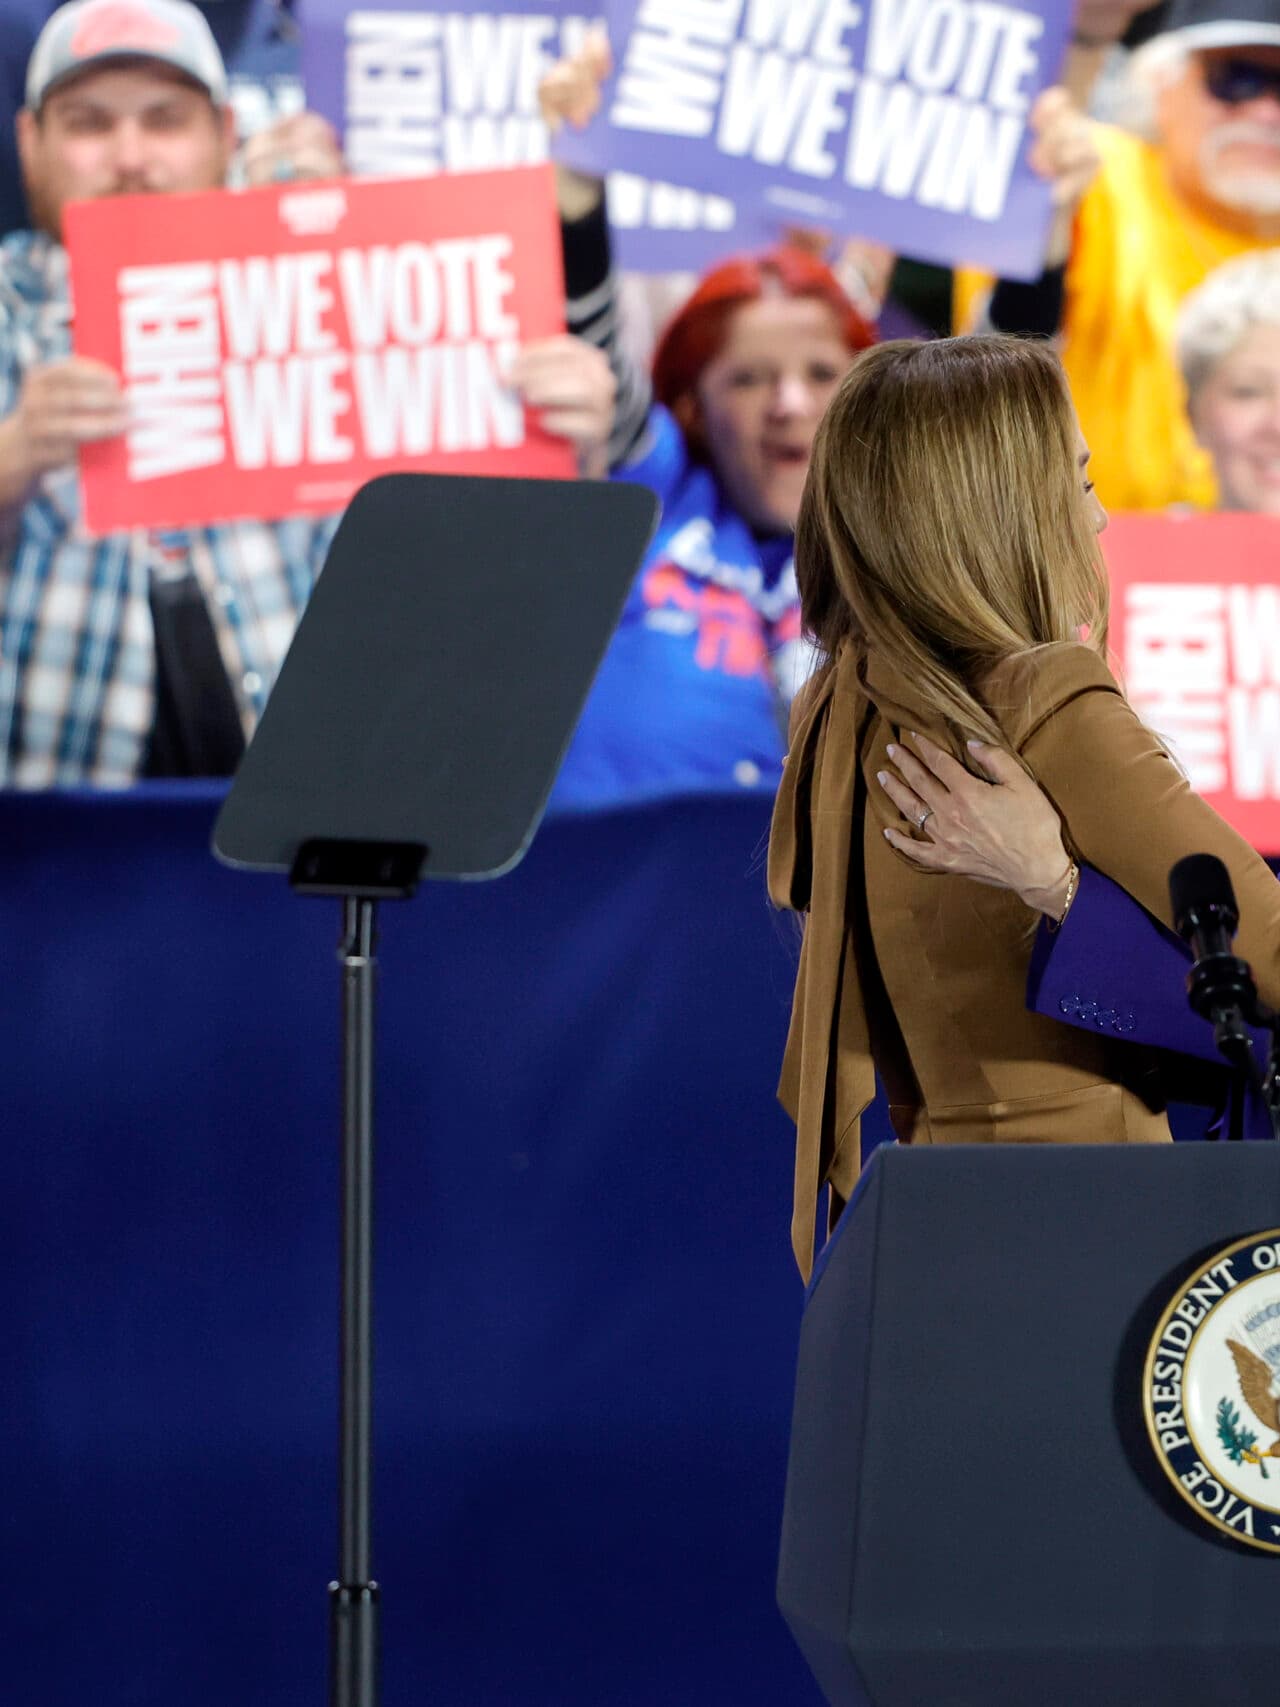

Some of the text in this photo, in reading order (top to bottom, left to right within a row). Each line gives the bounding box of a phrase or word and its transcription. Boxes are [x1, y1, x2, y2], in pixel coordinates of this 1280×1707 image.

[611, 0, 742, 138] WH
[866, 0, 1045, 110] VOTE
[717, 43, 855, 180] WE
[846, 76, 1025, 222] WIN
[217, 233, 520, 358] WE VOTE
[117, 261, 226, 482] WHEN
[223, 339, 526, 471] WE WIN
[1152, 1257, 1241, 1453] PRESIDENT
[1180, 1460, 1256, 1538] VICE
